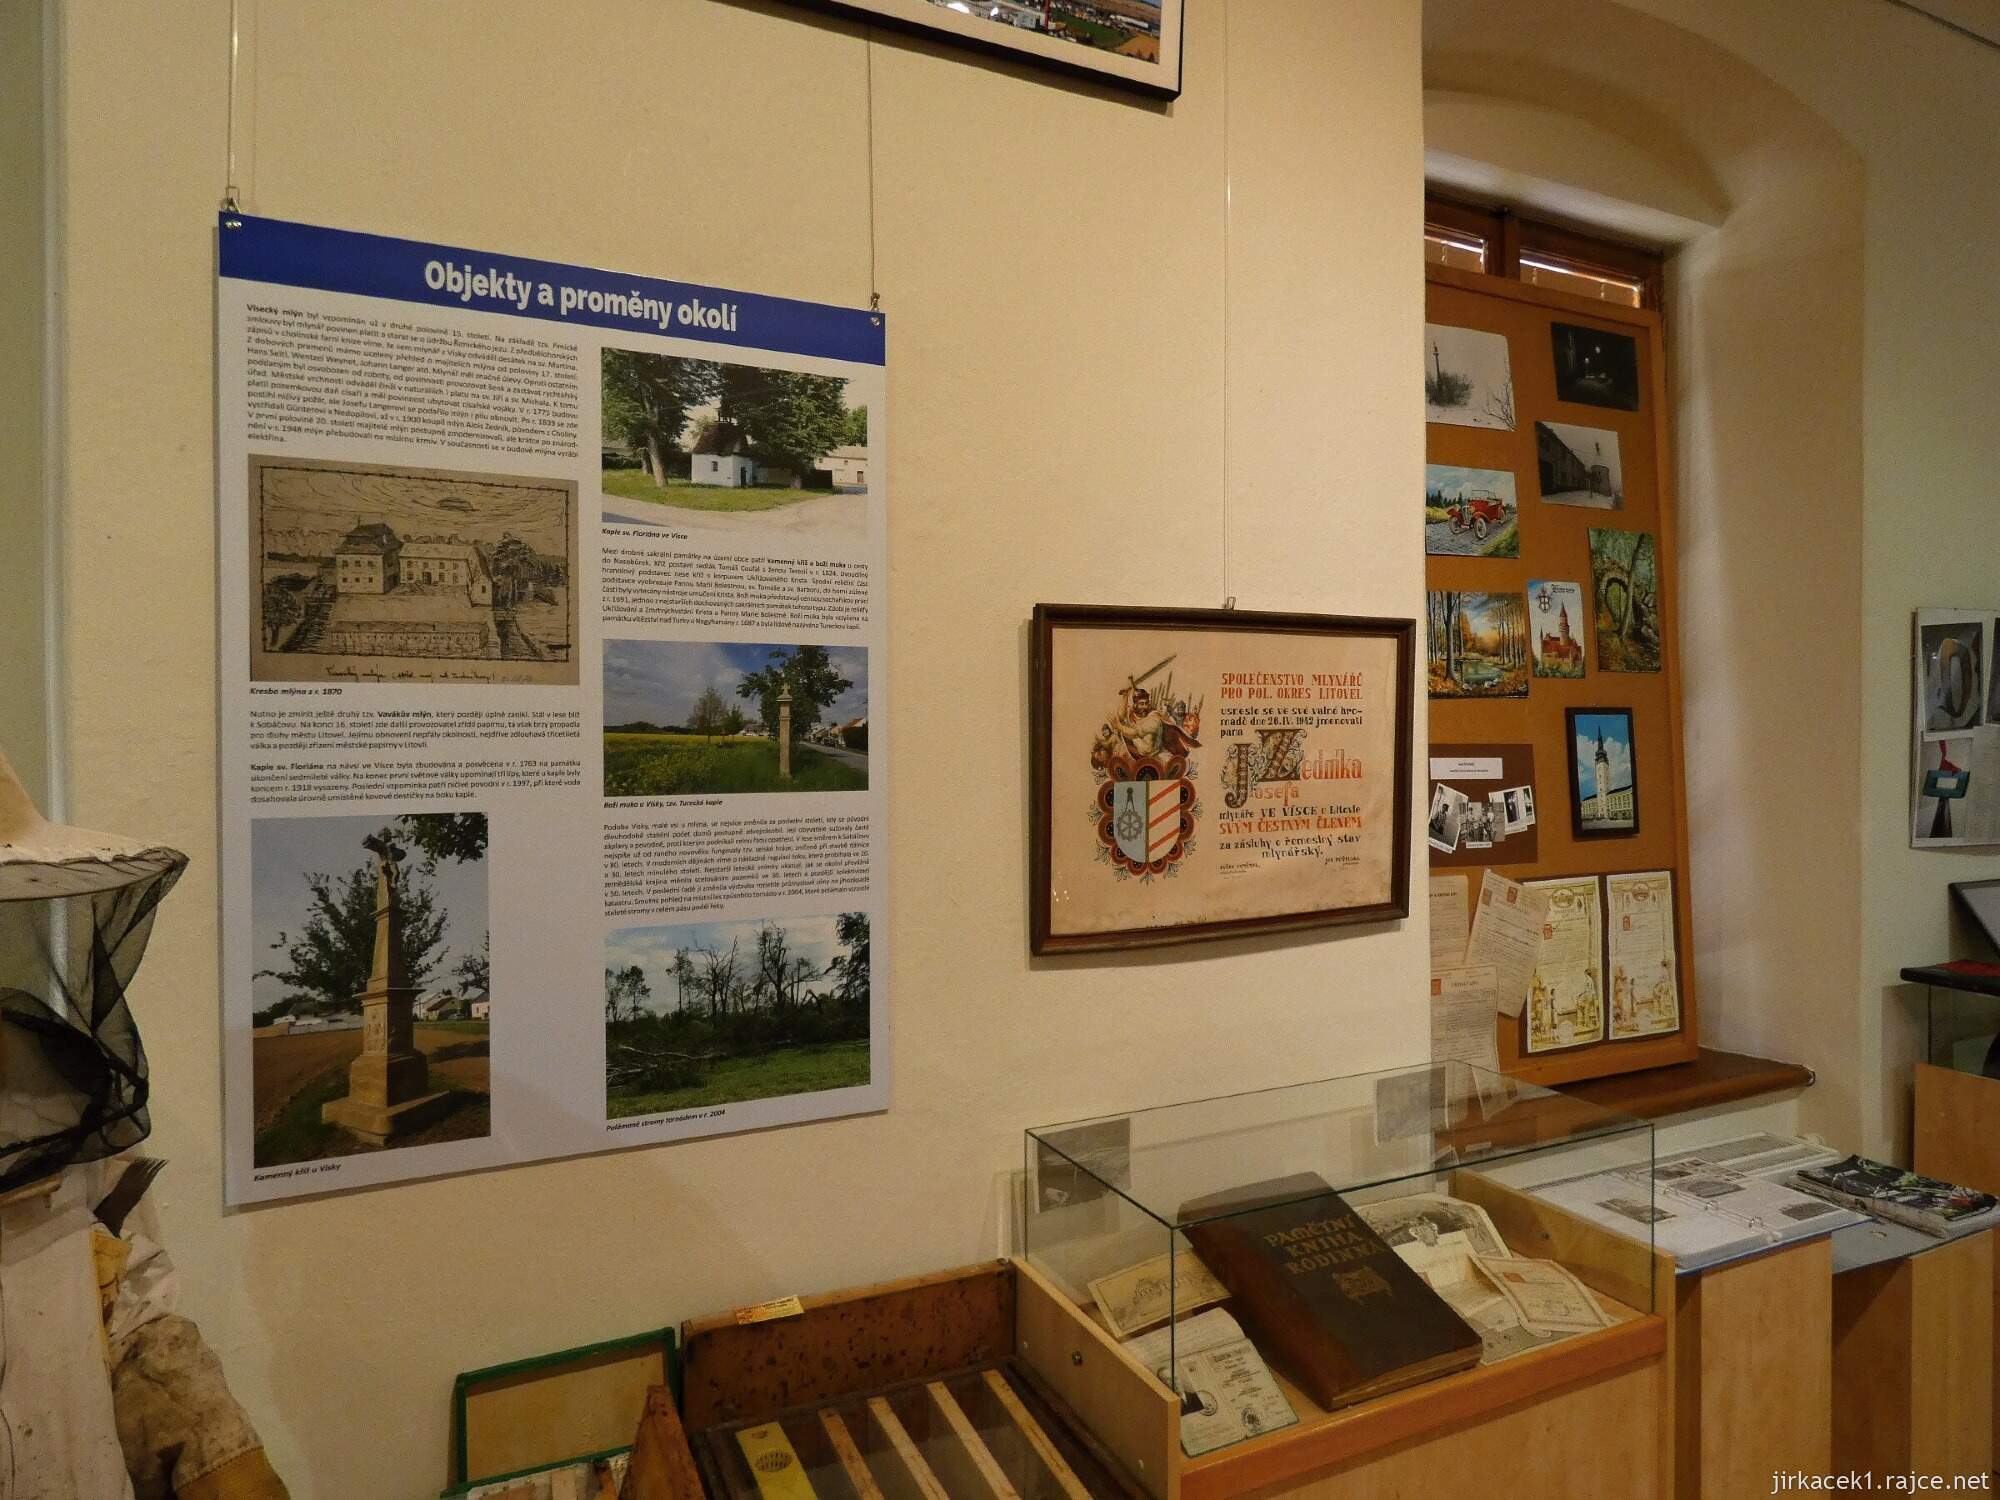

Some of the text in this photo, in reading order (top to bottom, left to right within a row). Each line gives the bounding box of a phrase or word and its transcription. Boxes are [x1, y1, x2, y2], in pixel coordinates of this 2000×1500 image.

[424, 260, 738, 332] Objekty a proměny okolí
[1222, 672, 1304, 686] SPOLEČENSTVO
[1221, 687, 1363, 700] PRO POL. OKRES LITOVEL
[1292, 706, 1308, 715] své
[1250, 716, 1265, 726] dne
[1296, 716, 1314, 725] 1942
[1315, 716, 1362, 728] jmenovati
[1261, 808, 1276, 817] VE
[1282, 805, 1318, 817] VÍSCE
[1219, 815, 1362, 834] SVÝM ČESTNÝM ČLENEM
[1338, 834, 1361, 844] stav
